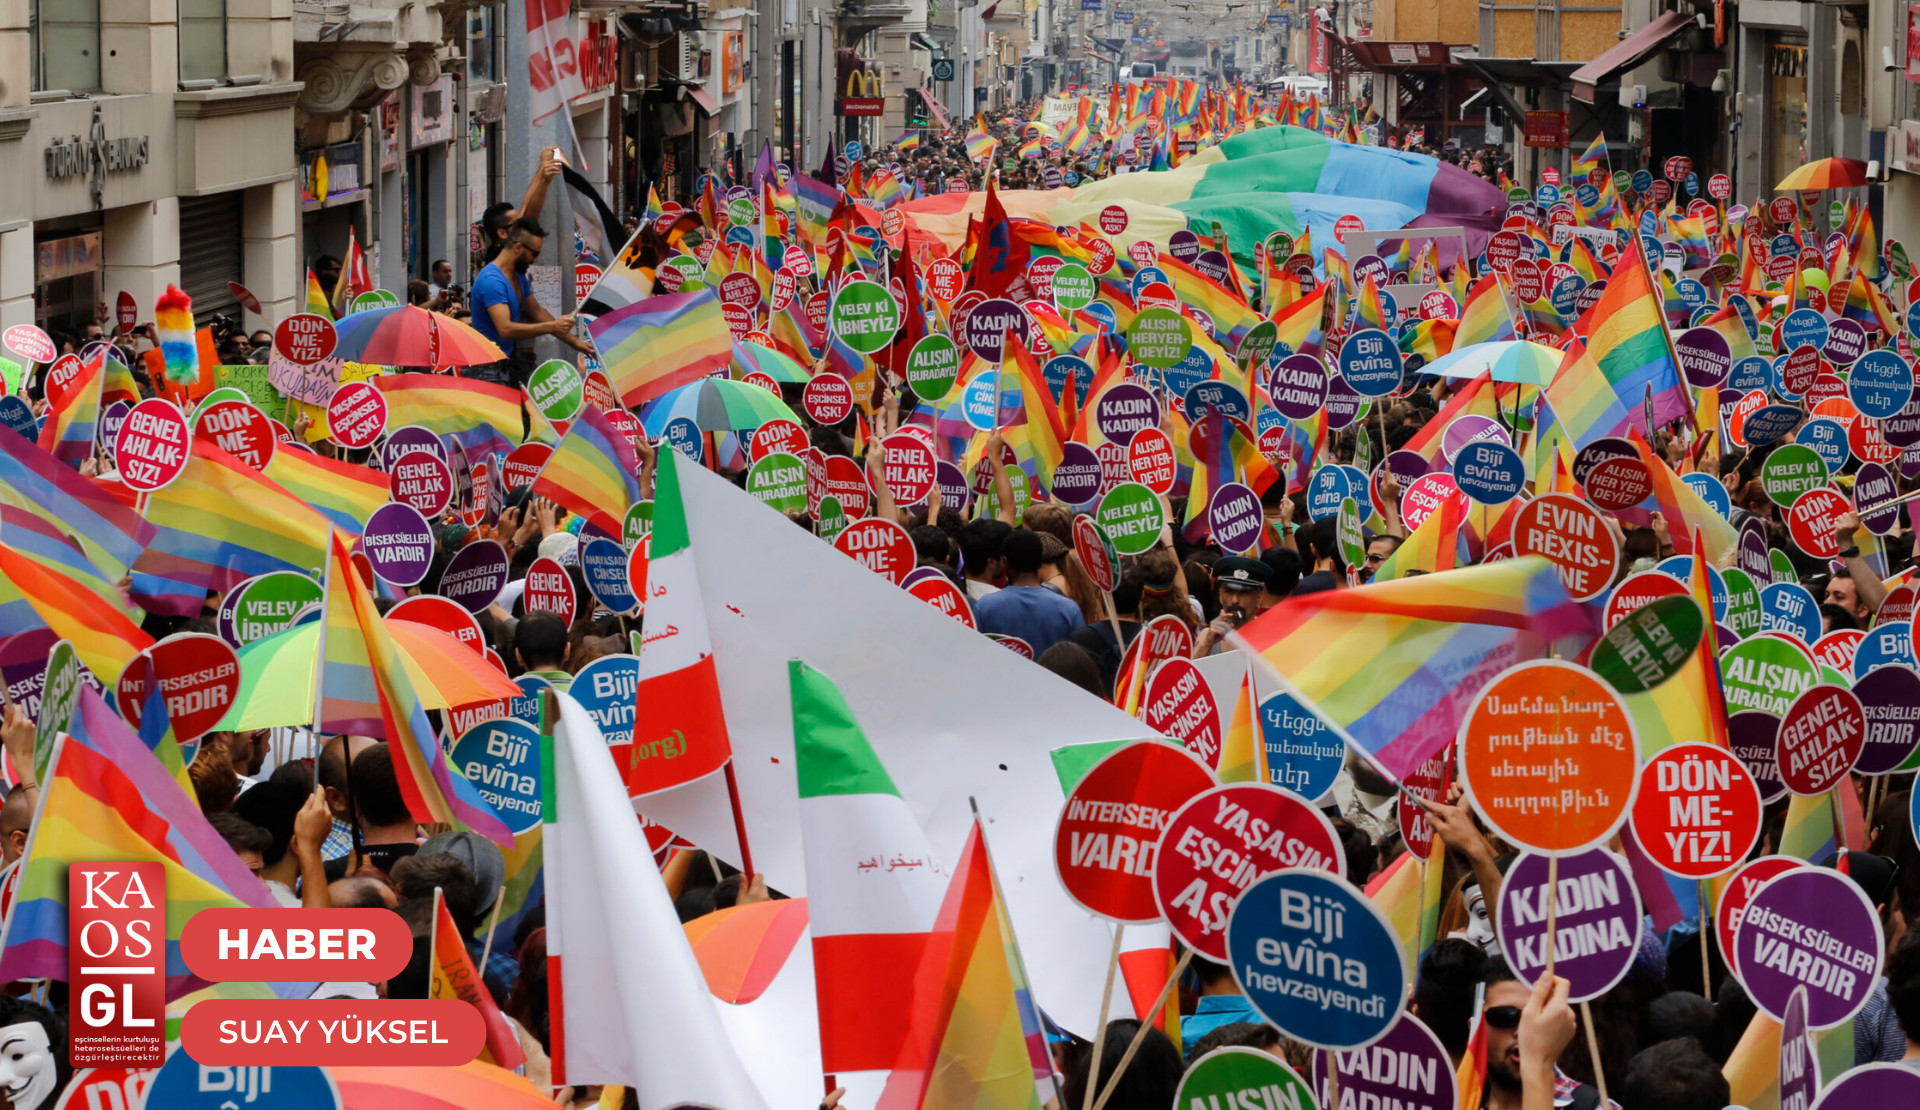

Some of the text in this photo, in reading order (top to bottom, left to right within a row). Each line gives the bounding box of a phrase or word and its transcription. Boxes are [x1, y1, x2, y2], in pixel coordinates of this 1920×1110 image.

[1102, 216, 1127, 224] EŞCİNSEL
[1104, 209, 1125, 217] YAŞASIN
[1107, 224, 1122, 232] AŞK!
[1494, 236, 1519, 246] YAŞASIN
[932, 262, 960, 276] DÖN-
[722, 277, 753, 292] GENEL
[935, 276, 956, 288] ME-
[1055, 276, 1089, 286] VELEV Kİ
[725, 285, 757, 301] AHLAK
[1054, 286, 1092, 298] İBNEYİZ
[1422, 293, 1447, 308] DÖN-
[1519, 288, 1538, 300] AŞK!
[838, 298, 889, 316] VELEV Kİ
[288, 319, 330, 333] DÖN-
[838, 315, 894, 336] İBNEYİZ
[972, 313, 1022, 330] KADIN
[1139, 318, 1181, 334] ALIŞIN
[293, 333, 323, 348] ME-
[1132, 332, 1188, 345] HERYER-
[1828, 328, 1862, 345] KADIN
[290, 346, 321, 362] YİZ!
[1138, 344, 1181, 359] DEYİZ!
[1356, 337, 1383, 355] Bijî
[1675, 343, 1730, 366] BİSEKSÜELLER
[914, 348, 954, 366] ALIŞIN
[1350, 356, 1393, 372] evîna
[1679, 354, 1723, 377] VARDIR
[1790, 352, 1817, 366] YAŞASIN
[909, 364, 957, 382] BURADAYIZ
[1346, 370, 1400, 384] hevzayendî
[1742, 362, 1760, 375] Bijî
[1787, 364, 1817, 378] EŞCİNSEL
[532, 365, 572, 400] ALIŞIN
[1277, 366, 1324, 390] KADIN
[1735, 376, 1765, 387] evîna
[1791, 374, 1812, 390] AŞK!
[810, 382, 846, 394] YAŞASIN
[1196, 387, 1224, 401] Bijî
[330, 386, 372, 416] YAŞASIN
[808, 393, 848, 406] EŞCİNSEL
[1272, 387, 1320, 408] KADINA
[814, 406, 842, 418] AŞK!
[1102, 398, 1150, 416] KADIN
[204, 407, 259, 433] DÖN-
[334, 400, 382, 433] EŞCİNSEL
[1102, 417, 1153, 434] KADINA
[129, 411, 182, 444] GENEL
[349, 414, 381, 445] AŞK!
[670, 422, 688, 440] Bijî
[759, 424, 797, 446] DÖN-
[1813, 425, 1834, 442] Bijî
[216, 430, 258, 452] ME-
[1134, 438, 1164, 456] ALIŞIN
[122, 434, 184, 467] AHLAK-
[1476, 447, 1504, 466] Bijî
[126, 459, 161, 486] SIZ!
[397, 459, 440, 480] GENEL
[1132, 458, 1152, 472] HER
[1464, 462, 1511, 482] evîna
[1604, 463, 1647, 482] ALIŞIN
[1769, 462, 1819, 476] VELEV Kİ
[754, 466, 804, 490] ALIŞIN
[1052, 475, 1097, 488] VARDIR
[1140, 466, 1172, 484] DEYİZ!
[1320, 472, 1336, 488] Bijî
[1458, 475, 1517, 493] hevzayendî
[398, 476, 445, 496] AHLAK
[1591, 474, 1648, 495] HER YER-
[1768, 476, 1824, 494] İBNEYİZ
[1857, 476, 1890, 500] KADIN
[409, 496, 436, 509] SIZ!
[1314, 489, 1340, 504] evîna
[1594, 487, 1636, 504] DEYİZ!
[1103, 498, 1154, 522] VELEV Kİ
[1213, 494, 1252, 524] KADIN
[1795, 495, 1837, 522] DÖN-
[1102, 515, 1161, 539] İBNEYİZ
[1218, 513, 1259, 543] KADINA
[1536, 500, 1596, 540] EVIN
[365, 533, 430, 546] BİSEKSÜELLER
[848, 526, 903, 551] DÖN-
[1527, 527, 1611, 568] RÊXIS-
[374, 546, 425, 564] VARDIR
[442, 562, 506, 586] BİSEKSÜELLER
[530, 572, 566, 592] GENEL
[446, 576, 498, 598] VARDIR
[246, 601, 297, 616] VELEV
[1776, 590, 1806, 616] Bijî
[1726, 656, 1811, 694] ALIŞIN
[1149, 668, 1199, 724] YAŞASIN
[1782, 694, 1849, 750] GENEL
[486, 729, 532, 768] Bijî
[1789, 714, 1861, 776] AHLAK-
[1657, 754, 1742, 792] DÖN-
[1807, 746, 1850, 788] SIZ!
[464, 760, 536, 796] evîna
[1669, 795, 1733, 830] ME-
[1213, 795, 1333, 871] YAŞASIN
[1665, 831, 1733, 864] YİZ!
[1510, 868, 1620, 927] KADIN
[1280, 888, 1347, 944] Bijî
[1515, 916, 1632, 971] KADINA
[1746, 905, 1875, 975] BİSEKSÜELLER
[1257, 938, 1368, 989] evîna
[1754, 933, 1856, 1001] VARDIR
[1246, 965, 1387, 1019] hevzayendî
